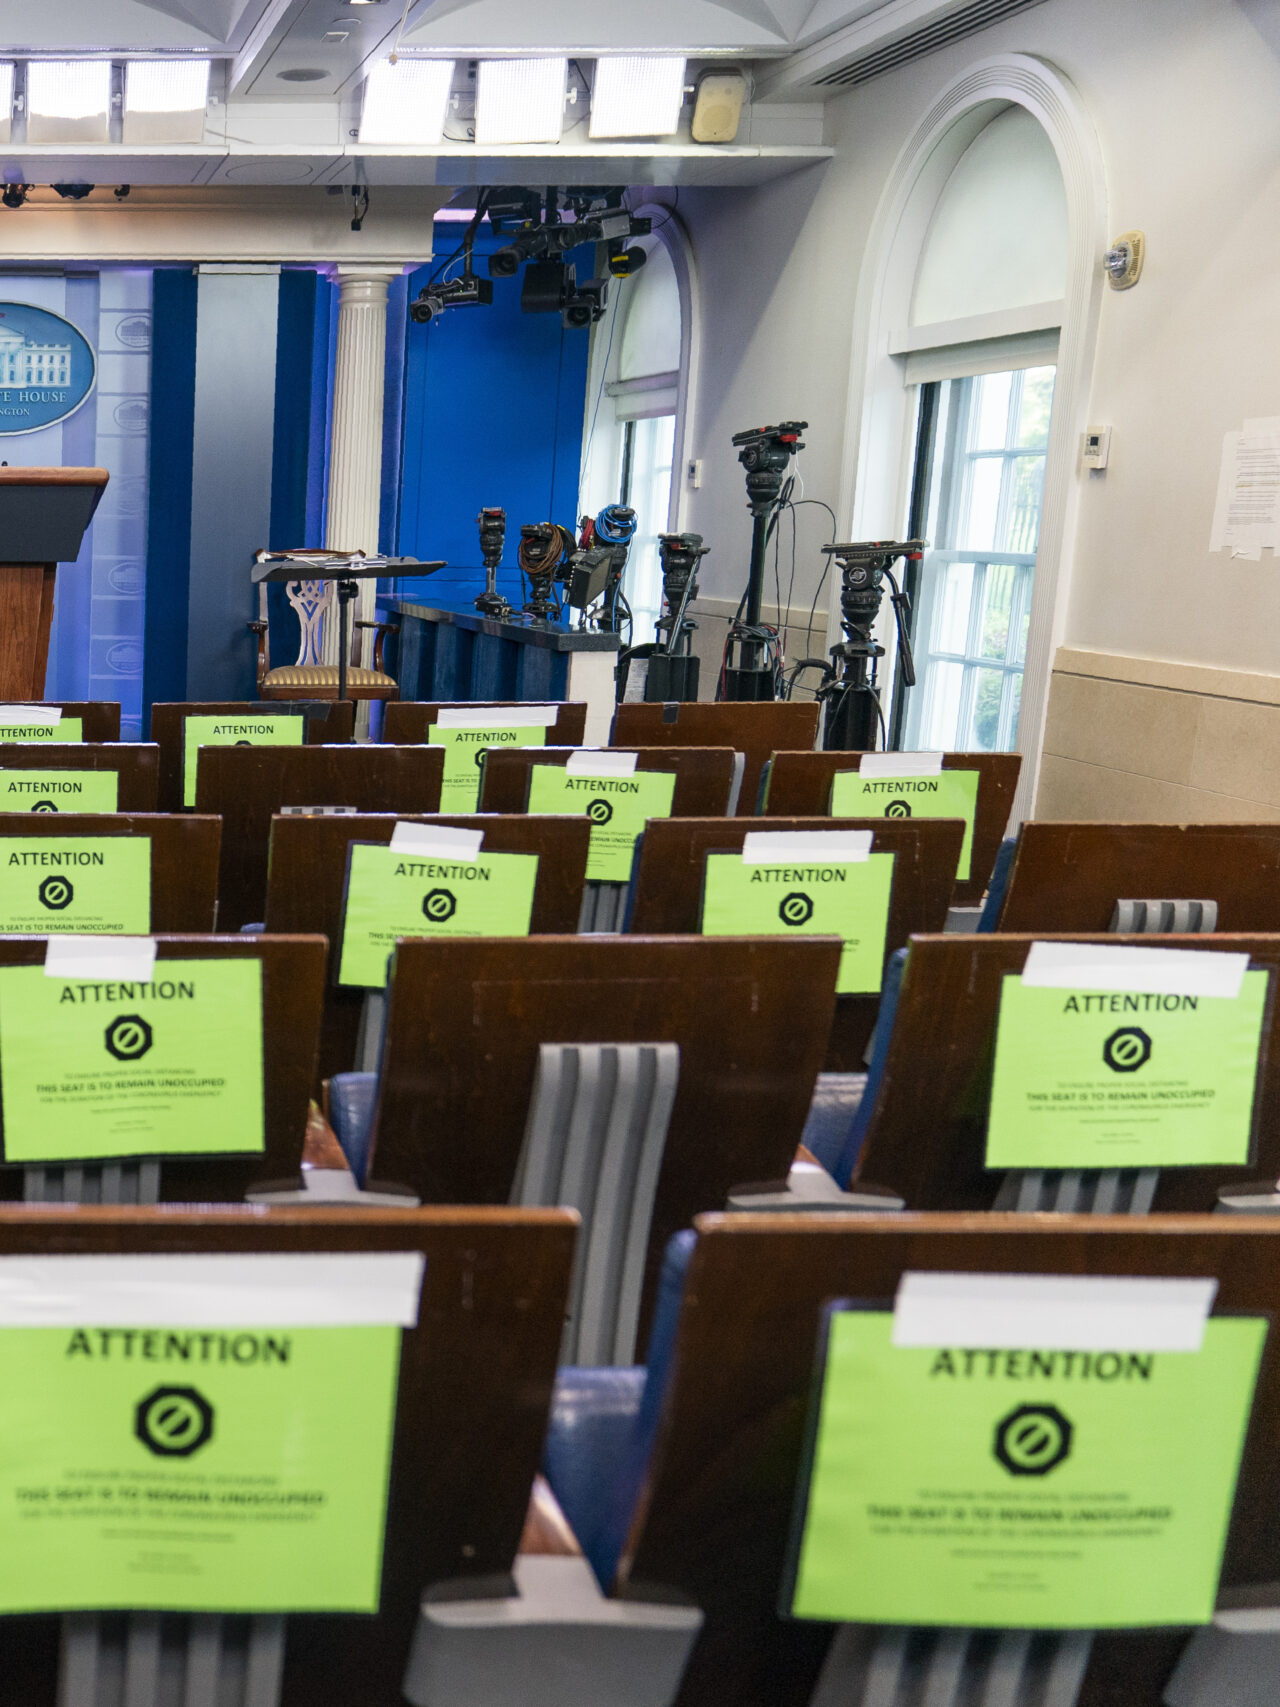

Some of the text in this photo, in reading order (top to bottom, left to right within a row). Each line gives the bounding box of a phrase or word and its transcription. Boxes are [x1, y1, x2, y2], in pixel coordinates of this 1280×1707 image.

[19, 391, 67, 403] HOUSE
[213, 725, 273, 734] ATTENTION
[456, 733, 516, 741] ATTENTION
[8, 782, 82, 793] ATTENTION
[565, 779, 639, 793] ATTENTION
[863, 782, 938, 793] ATTENTION
[9, 852, 103, 865] ATTENTION
[395, 863, 490, 880] ATTENTION
[751, 869, 846, 882] ATTENTION
[60, 981, 194, 1003] ATTENTION
[1064, 994, 1198, 1012] ATTENTION
[36, 1078, 225, 1093] THIS SEAT IS TO REMAIN UNOCCUPIED
[66, 1329, 291, 1364] ATTENTION
[931, 1350, 1153, 1381] ATTENTION
